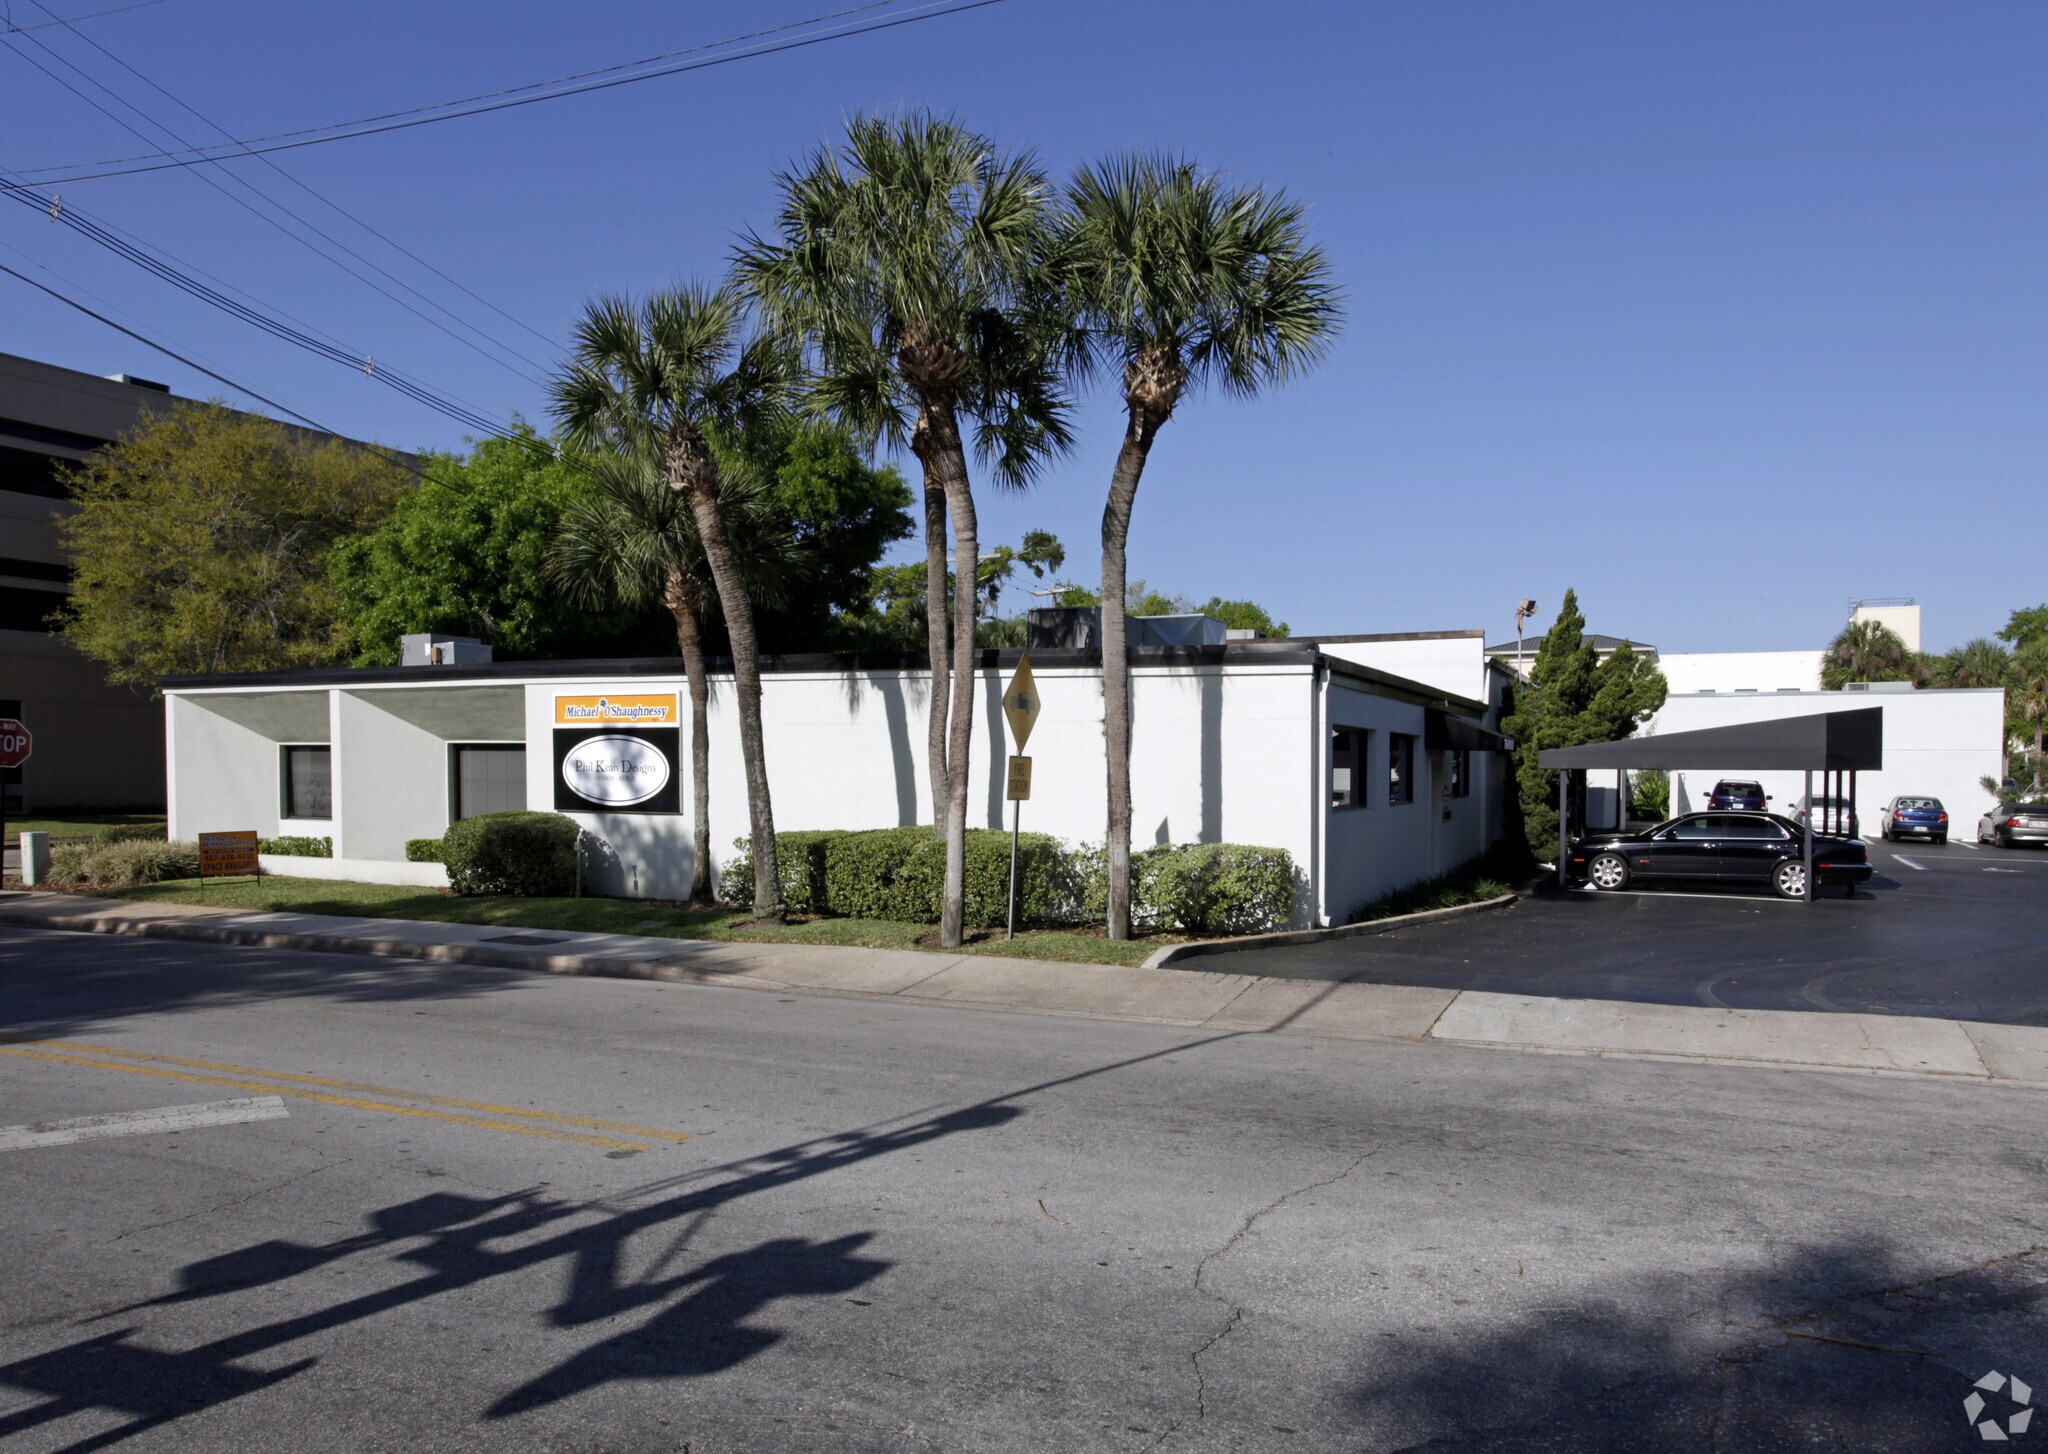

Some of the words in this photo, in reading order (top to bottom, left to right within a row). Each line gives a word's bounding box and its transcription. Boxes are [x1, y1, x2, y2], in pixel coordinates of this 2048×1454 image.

[566, 705, 599, 717] Michael
[604, 705, 668, 719] O'Shaughnessy
[0, 723, 16, 731] -WAY
[0, 735, 27, 752] OP
[575, 760, 593, 773] Phil
[595, 760, 619, 773] Kean
[621, 760, 657, 776] Designs
[1014, 762, 1025, 776] FIRE
[1009, 779, 1028, 792] STATION
[203, 862, 223, 871] SPACE
